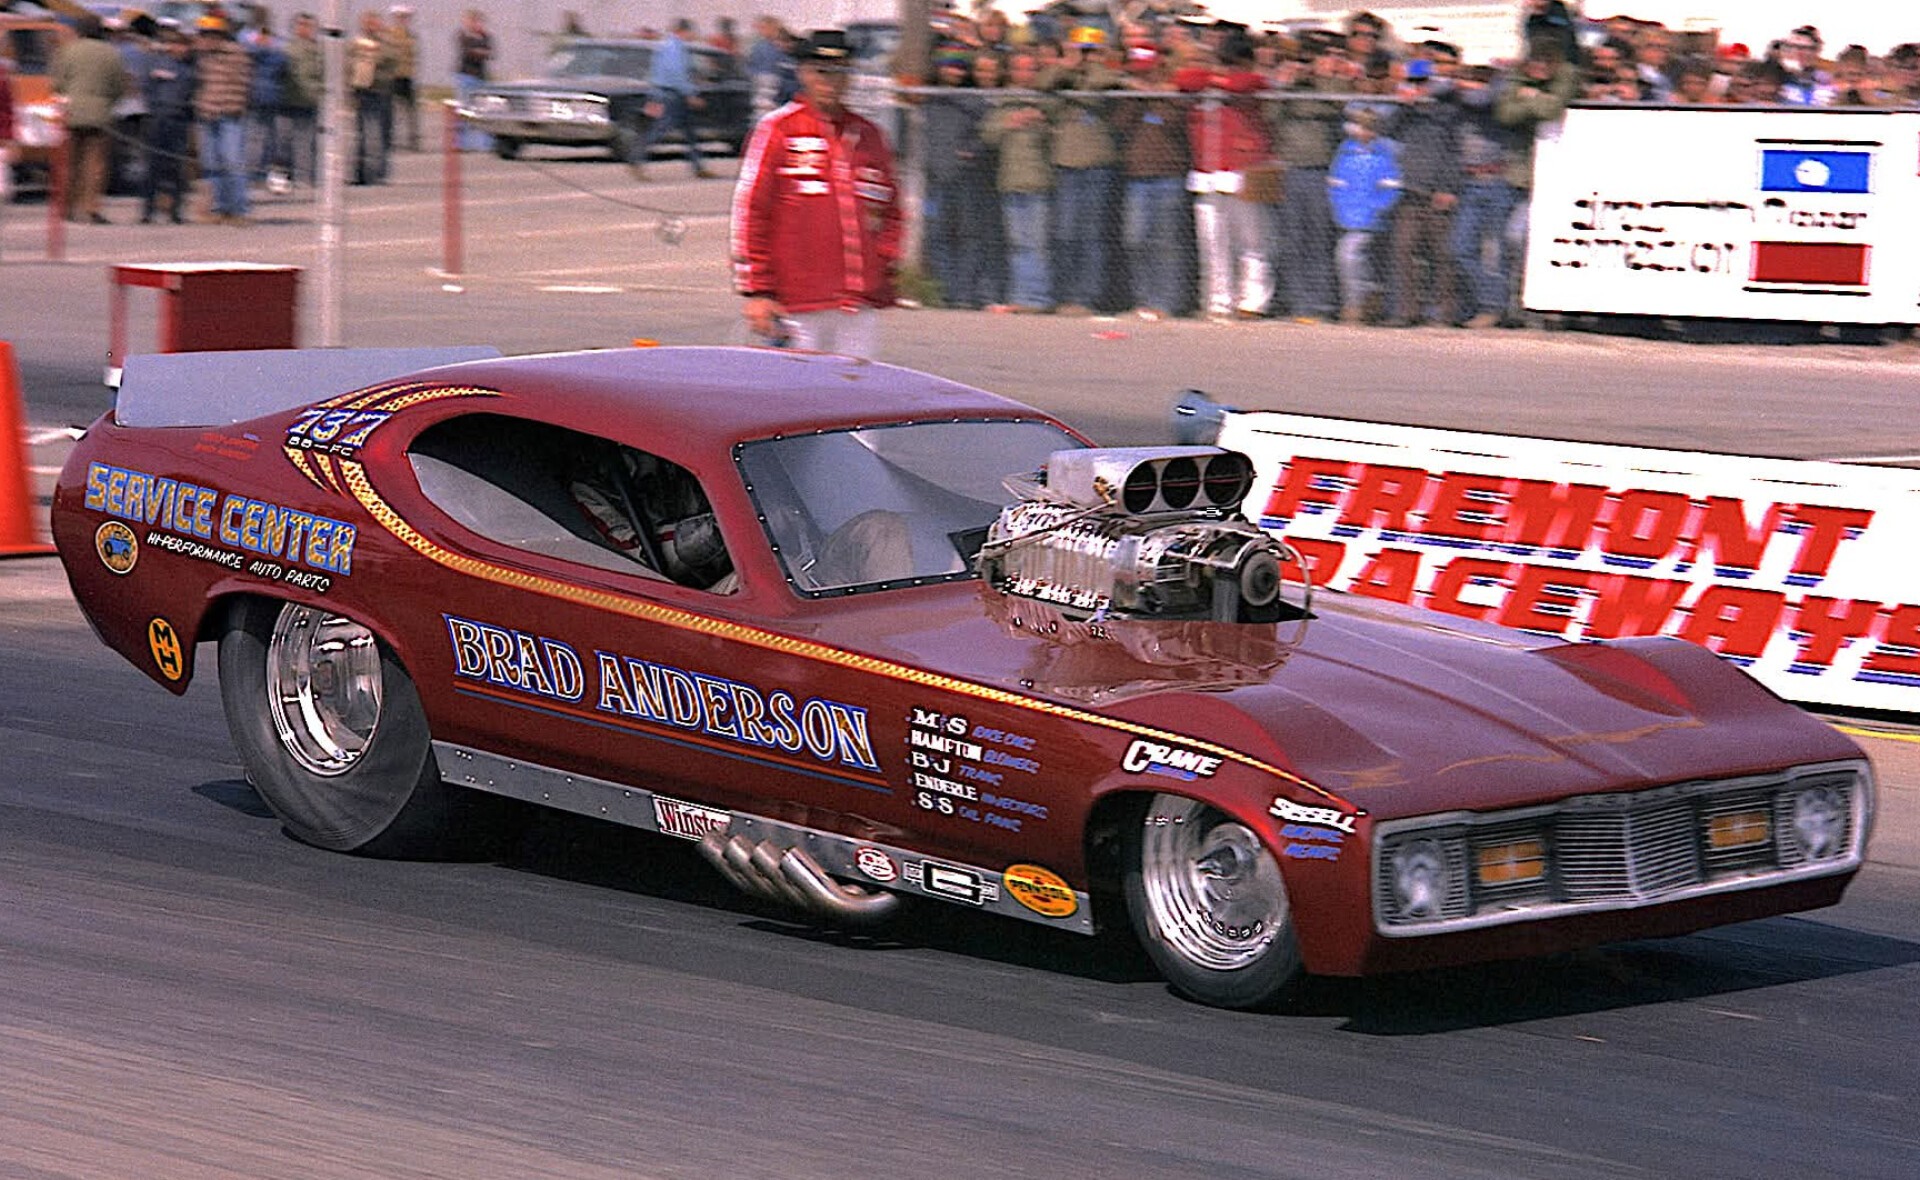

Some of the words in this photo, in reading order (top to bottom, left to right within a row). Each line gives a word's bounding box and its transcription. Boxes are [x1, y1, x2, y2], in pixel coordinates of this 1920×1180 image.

[85, 461, 218, 539] SERVICE
[219, 495, 357, 576] CENTER
[1266, 456, 1875, 580] FREMONT
[249, 560, 282, 580] AUTO
[284, 567, 330, 592] PARTS
[444, 616, 585, 701] BRAD
[596, 650, 881, 772] ANDERSON
[911, 729, 983, 761] HAMPTON
[1122, 739, 1223, 777] CRANE
[914, 772, 978, 801] ENDERLE
